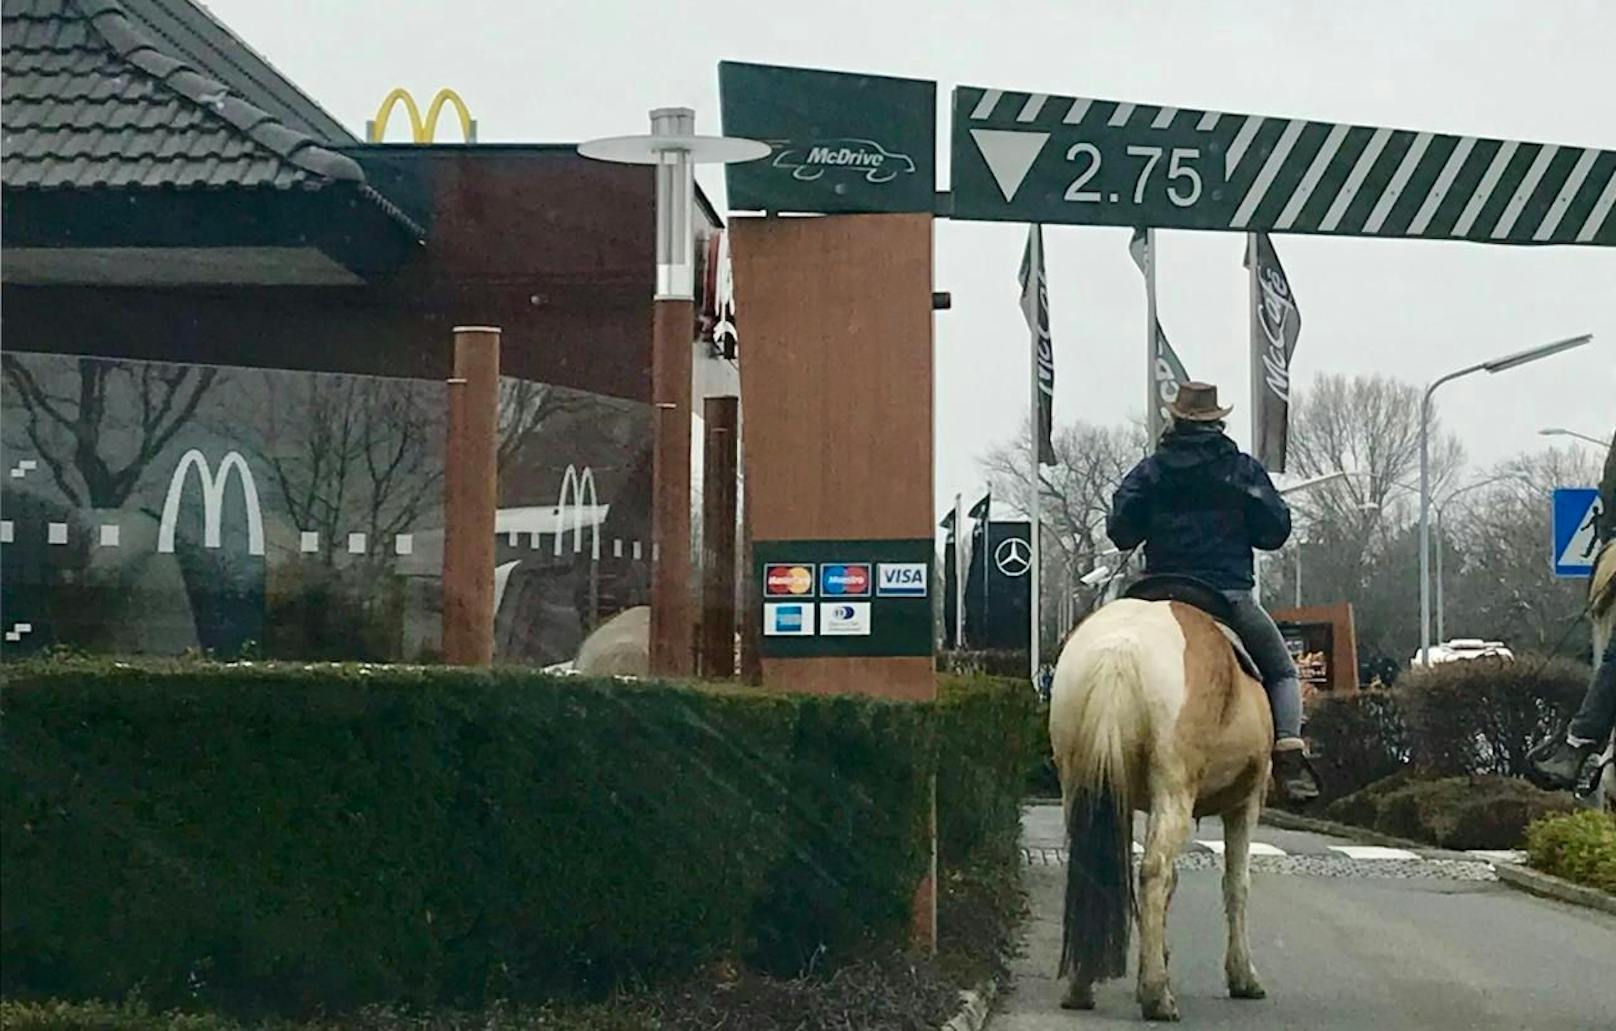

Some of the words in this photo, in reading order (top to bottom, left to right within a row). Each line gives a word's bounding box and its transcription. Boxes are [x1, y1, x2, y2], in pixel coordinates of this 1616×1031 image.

[806, 147, 884, 167] McDrive
[1064, 142, 1203, 208] 2.75
[1257, 264, 1294, 401] McCafé
[884, 568, 923, 584] VISA
